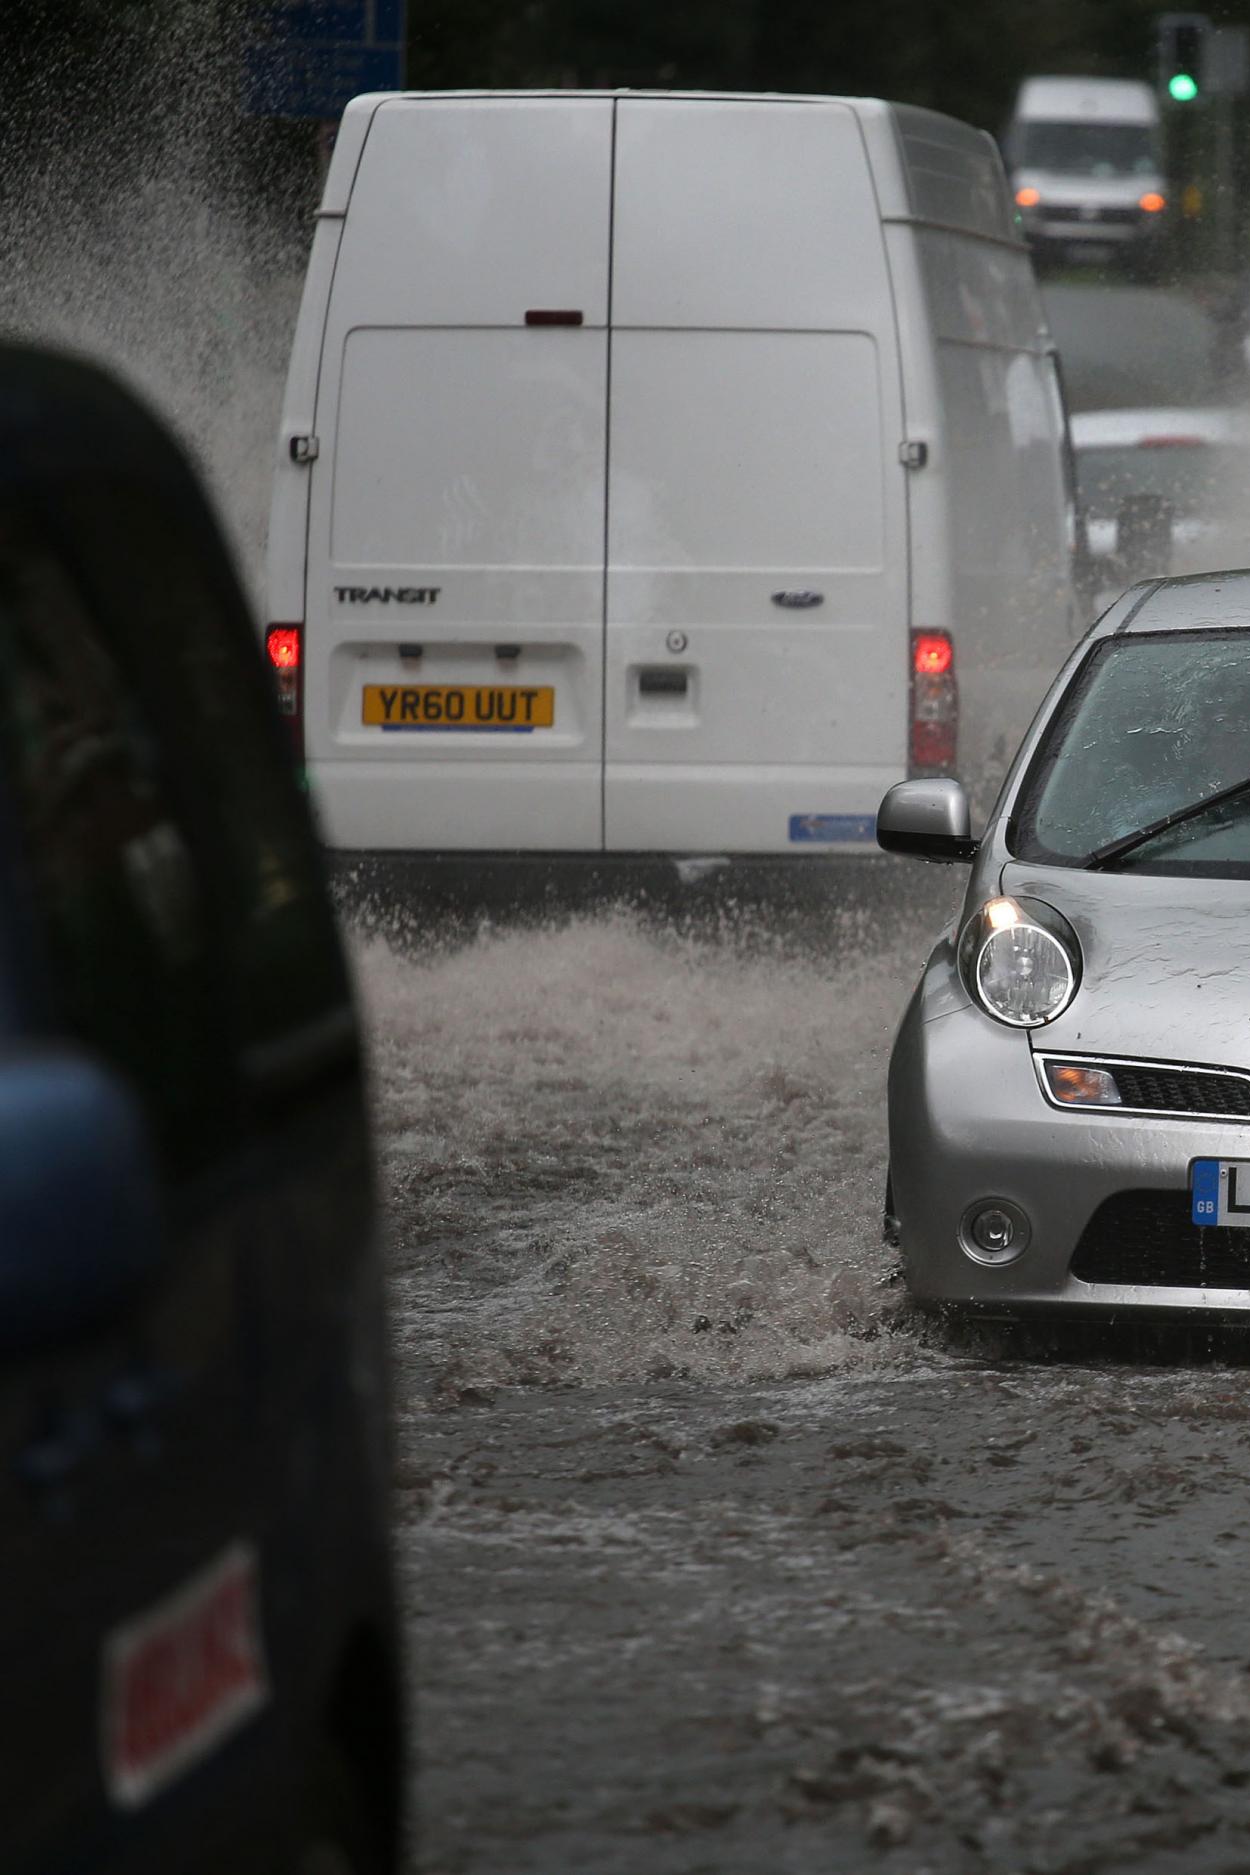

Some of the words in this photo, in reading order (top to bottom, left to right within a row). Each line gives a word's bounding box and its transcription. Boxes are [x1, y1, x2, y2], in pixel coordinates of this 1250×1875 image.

[333, 586, 441, 603] TRANSIT
[379, 690, 466, 721] YR60
[474, 691, 539, 722] UUT
[1196, 1200, 1214, 1214] GB
